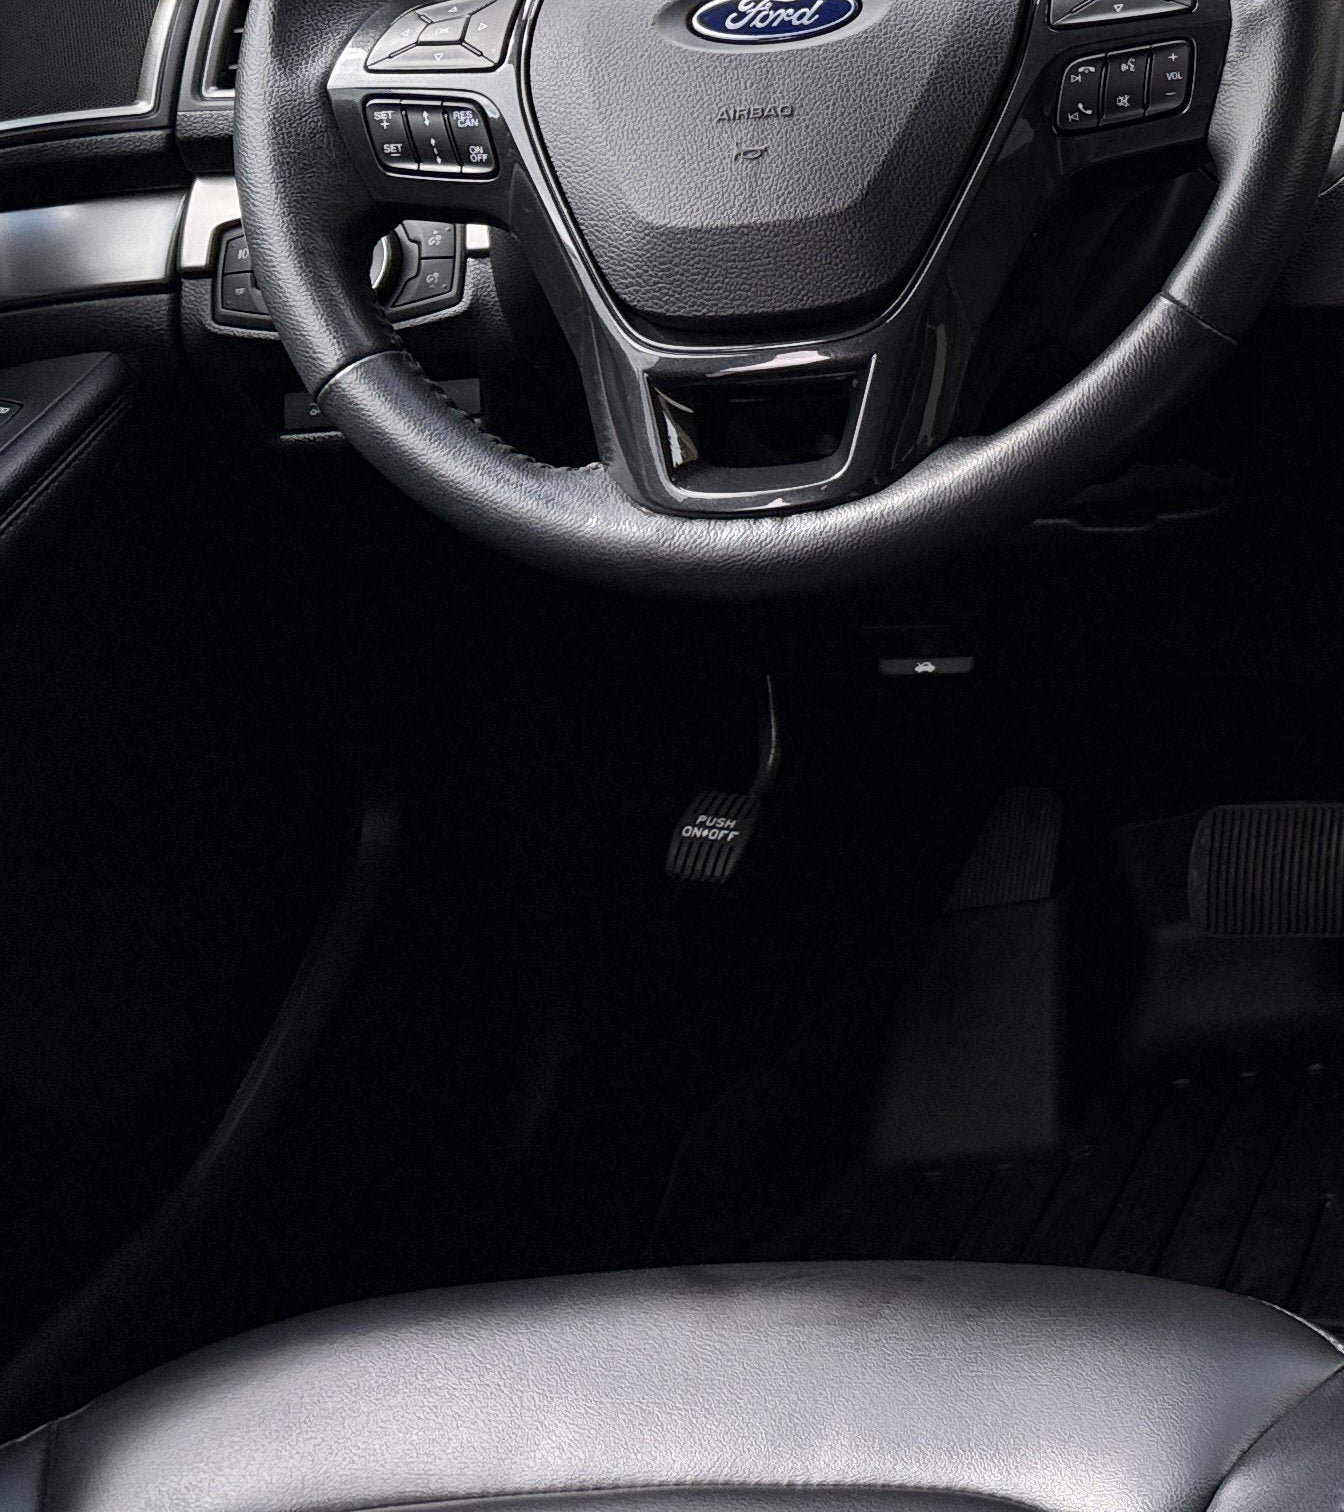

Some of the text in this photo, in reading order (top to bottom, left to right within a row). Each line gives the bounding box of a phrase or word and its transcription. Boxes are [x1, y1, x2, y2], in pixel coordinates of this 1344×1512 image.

[1166, 72, 1183, 80] VOL
[374, 111, 395, 120] SET
[453, 111, 474, 119] RES
[715, 104, 795, 123] AIRBAG
[457, 119, 479, 128] CAN
[383, 144, 403, 153] SET
[469, 146, 484, 154] ON
[469, 154, 488, 162] OFF
[696, 815, 737, 830] PUSH
